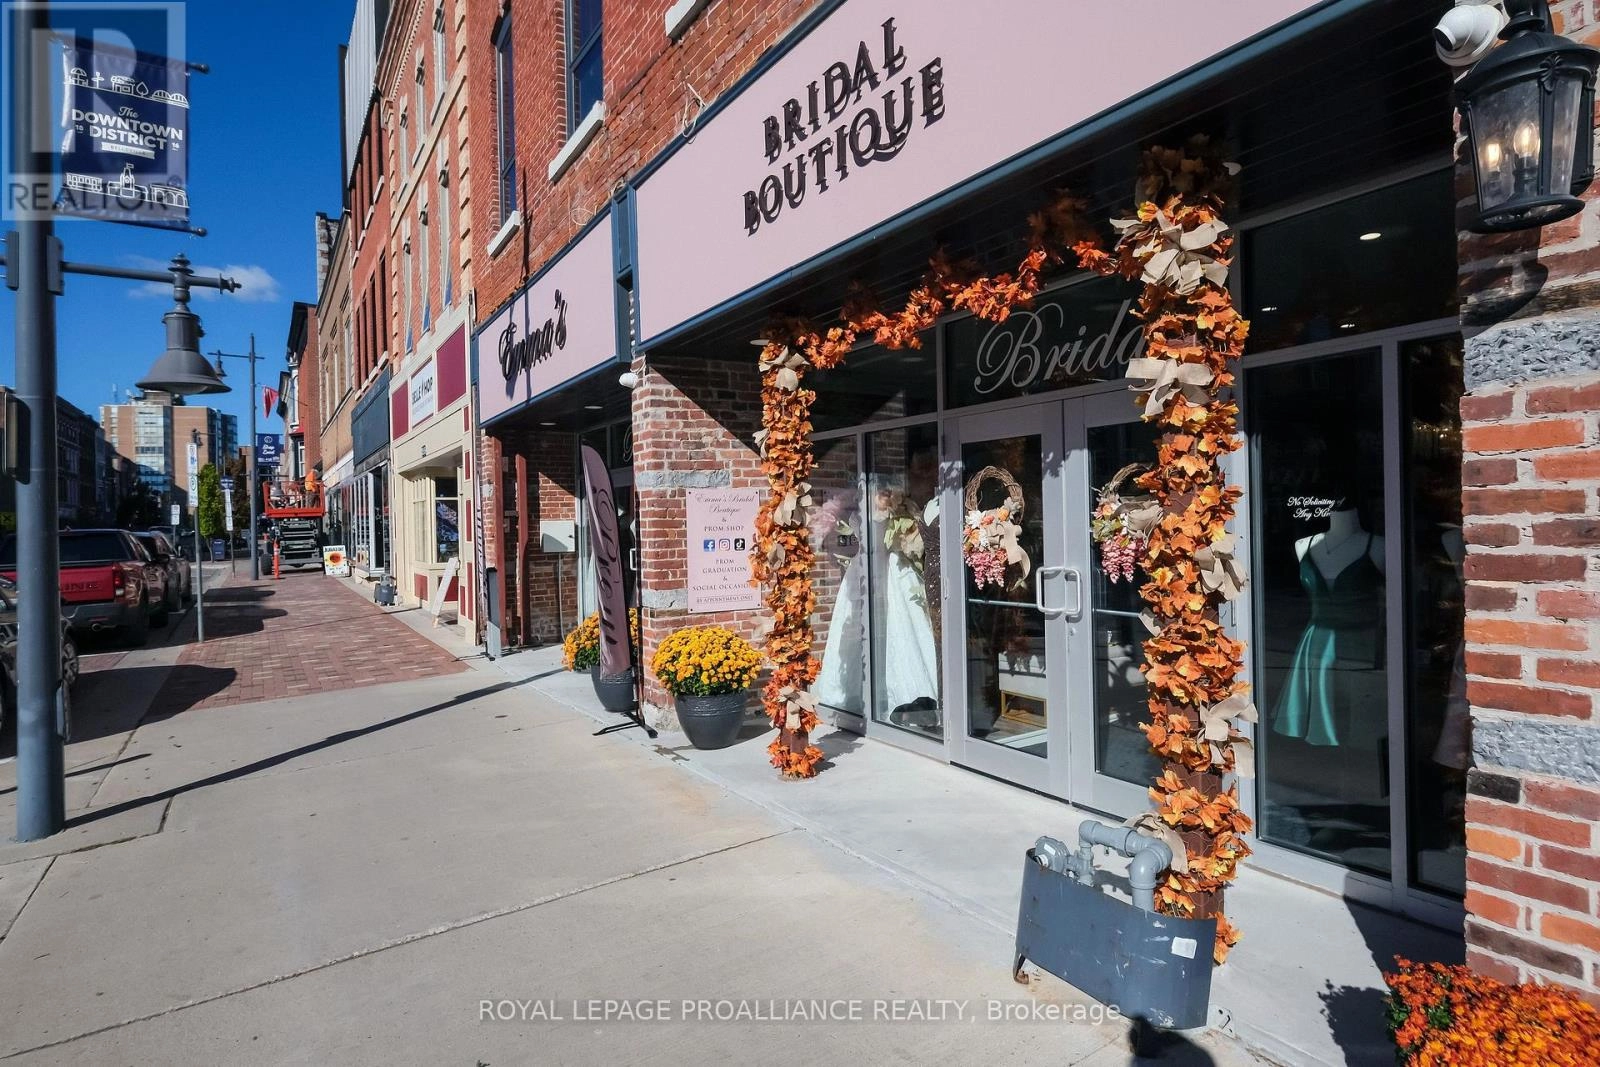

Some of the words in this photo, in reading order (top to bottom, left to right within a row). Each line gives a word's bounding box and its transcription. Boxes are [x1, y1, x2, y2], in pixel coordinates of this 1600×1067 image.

[762, 17, 906, 162] BRIDAL
[71, 109, 183, 140] DOWNTOWN
[118, 106, 139, 119] The
[89, 125, 167, 150] DISTRICT
[742, 57, 945, 234] BOUTIQUE
[498, 289, 567, 381] Emma's
[974, 299, 1147, 394] Brida
[1287, 496, 1304, 507] No
[1302, 496, 1336, 508] Soliciting
[1293, 508, 1312, 521] Any
[1313, 507, 1332, 518] Kin
[702, 566, 747, 574] GRADUATION
